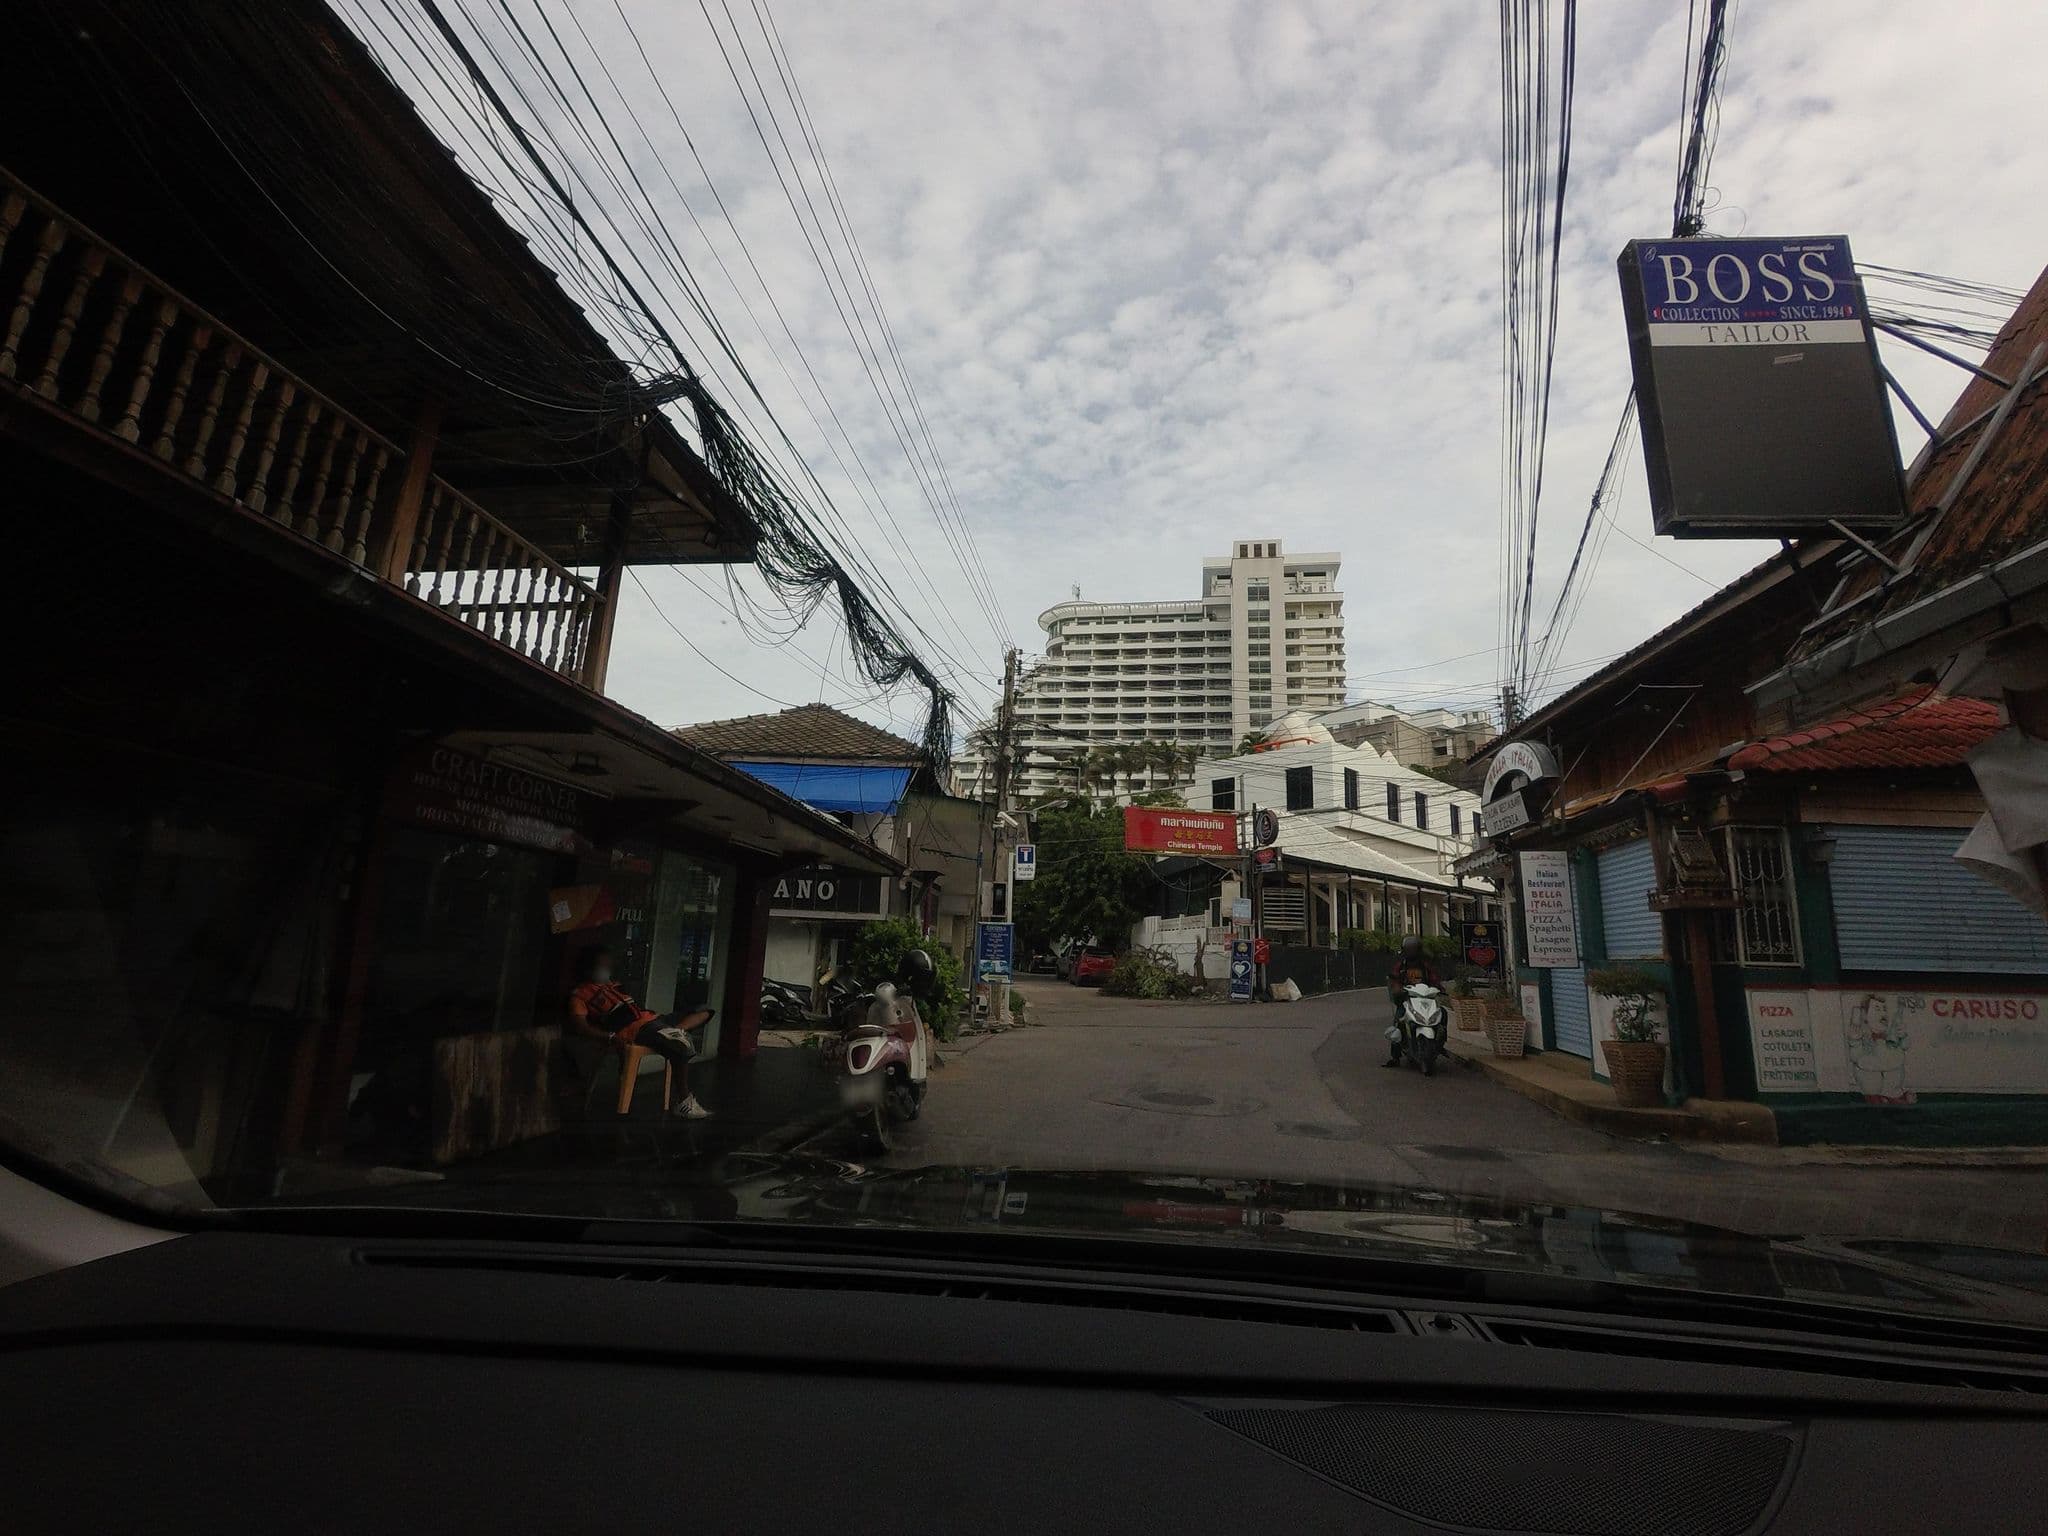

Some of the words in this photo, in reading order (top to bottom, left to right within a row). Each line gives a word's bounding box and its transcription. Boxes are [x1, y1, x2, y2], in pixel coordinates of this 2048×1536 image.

[1657, 252, 1835, 304] BOSS
[1660, 306, 1740, 322] COLLECTION
[1700, 323, 1810, 344] TAILOR
[1511, 750, 1534, 775] ITALIA
[431, 749, 505, 788] CRAFT
[507, 773, 577, 811] CORNER
[1167, 840, 1196, 849] Chinese
[1197, 842, 1224, 852] Temple
[1536, 869, 1558, 879] Italian
[1531, 890, 1562, 899] BELLA
[1531, 900, 1563, 909] ITALIA
[1533, 915, 1562, 923] PIZZA
[1529, 924, 1571, 935] Spaghetti
[1534, 935, 1570, 945] Lasagne
[1533, 946, 1572, 955] Espresso
[1759, 1005, 1793, 1017] PIZZA
[1932, 998, 2039, 1021] CARUSO
[1764, 1056, 1806, 1067] FILETTO
